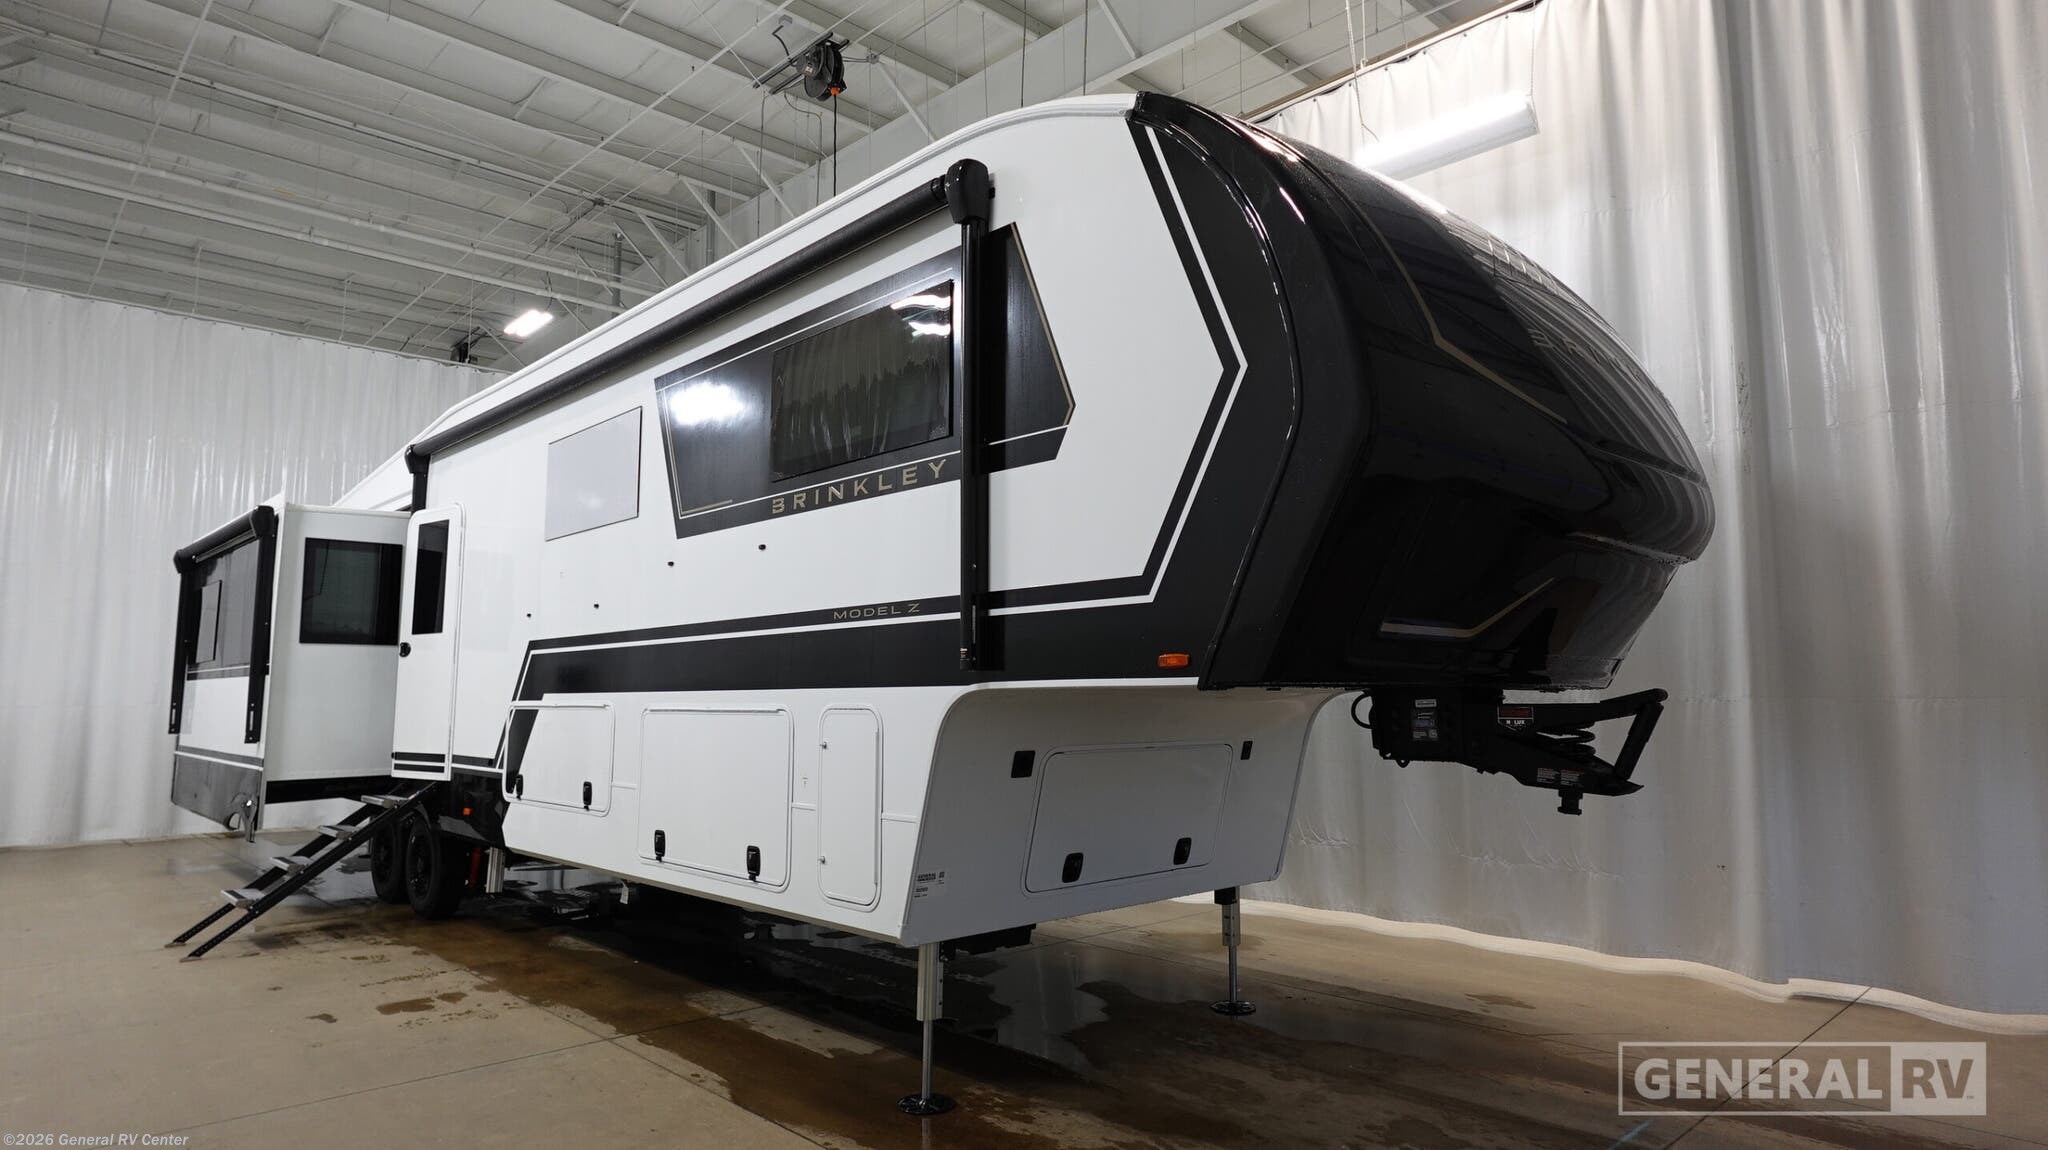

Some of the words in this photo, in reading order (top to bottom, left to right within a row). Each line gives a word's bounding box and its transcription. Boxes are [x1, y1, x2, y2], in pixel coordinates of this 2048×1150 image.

[771, 458, 947, 514] BRINKLEY
[833, 605, 901, 620] MODEL
[907, 602, 920, 613] Z
